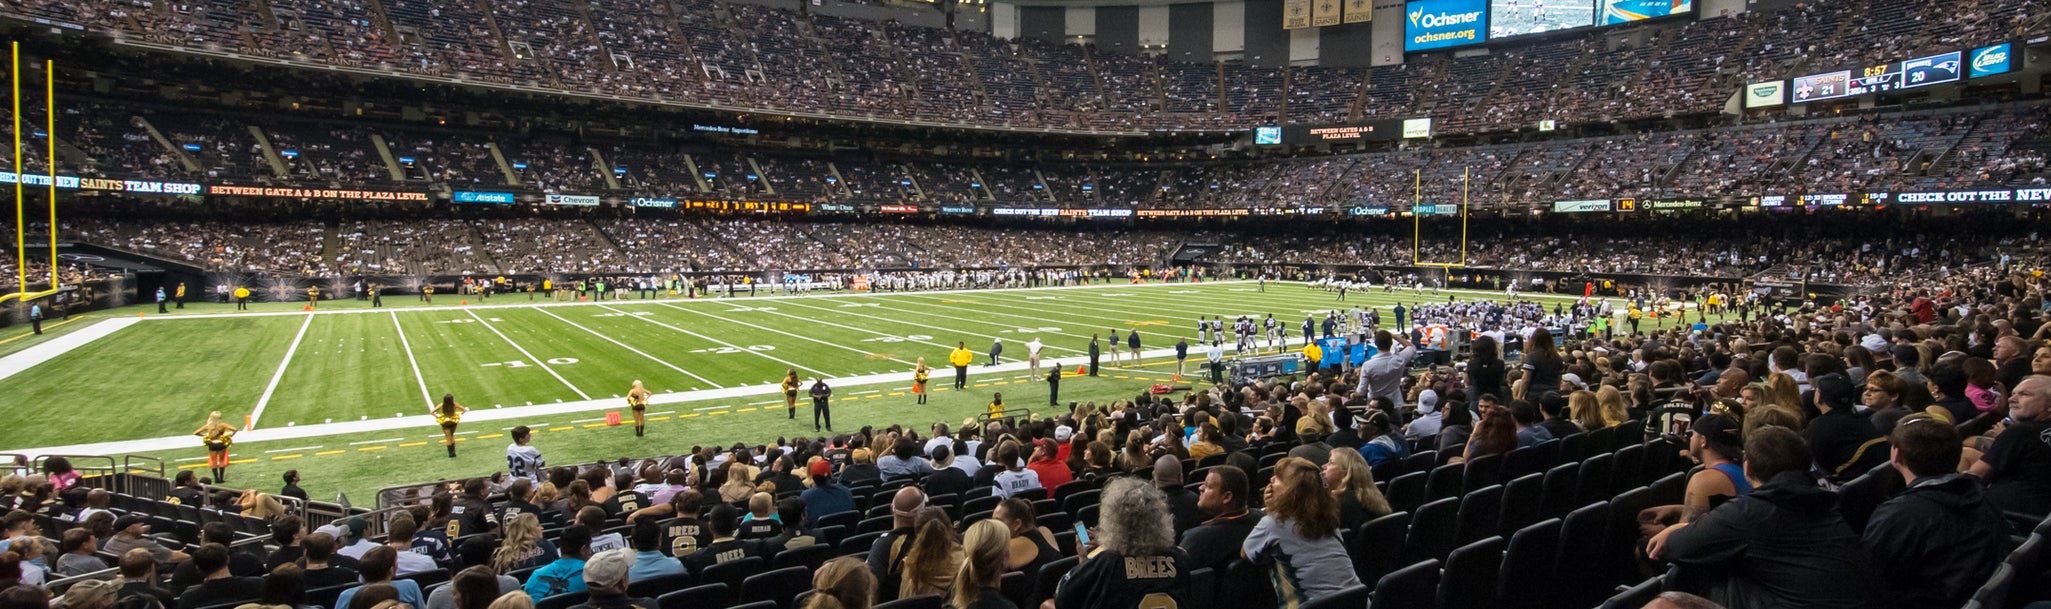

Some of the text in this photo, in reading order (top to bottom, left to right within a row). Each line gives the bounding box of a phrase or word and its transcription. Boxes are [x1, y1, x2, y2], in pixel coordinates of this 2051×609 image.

[1422, 11, 1480, 28] Ochsner
[145, 34, 184, 46] SAINTS
[1414, 29, 1476, 44] ochsner.org
[240, 46, 277, 58] SAINTS
[1984, 52, 2006, 60] BUD
[327, 57, 362, 67] SAINTS
[1978, 56, 2007, 67] LIGHT
[1864, 64, 1888, 77] 8:57
[1816, 75, 1845, 85] SAINTS
[1911, 71, 1925, 83] 20
[1821, 84, 1834, 95] 21
[1894, 81, 1900, 89] 3
[1310, 127, 1339, 135] BETWEEN
[21, 174, 38, 185] OUT
[55, 176, 80, 188] NEW
[80, 178, 124, 190] SAINTS
[125, 181, 162, 193] TEAM
[163, 182, 201, 194] SHOP
[210, 186, 429, 201] BETWEEN GATE A & B ON THE PLAZA LEVEL
[475, 193, 506, 203] Allstate
[1898, 192, 1946, 202] CHECK
[1946, 191, 1977, 201] OUT
[1978, 190, 2011, 200] THE
[563, 195, 595, 205] Chevron
[637, 197, 674, 208] Ochsner
[1621, 200, 1633, 209] 14
[1653, 200, 1702, 208] Mercedes-Benz
[1041, 208, 1059, 216] NEW
[1059, 208, 1087, 216] SAINTS
[1110, 209, 1132, 217] SHOP
[1354, 206, 1386, 215] Ochsner
[1412, 205, 1435, 213] POPLES
[1011, 479, 1029, 489] BRADY
[446, 519, 460, 548] 9
[668, 525, 700, 538] BREES
[715, 548, 745, 565] BREES
[1124, 556, 1177, 580] BREES
